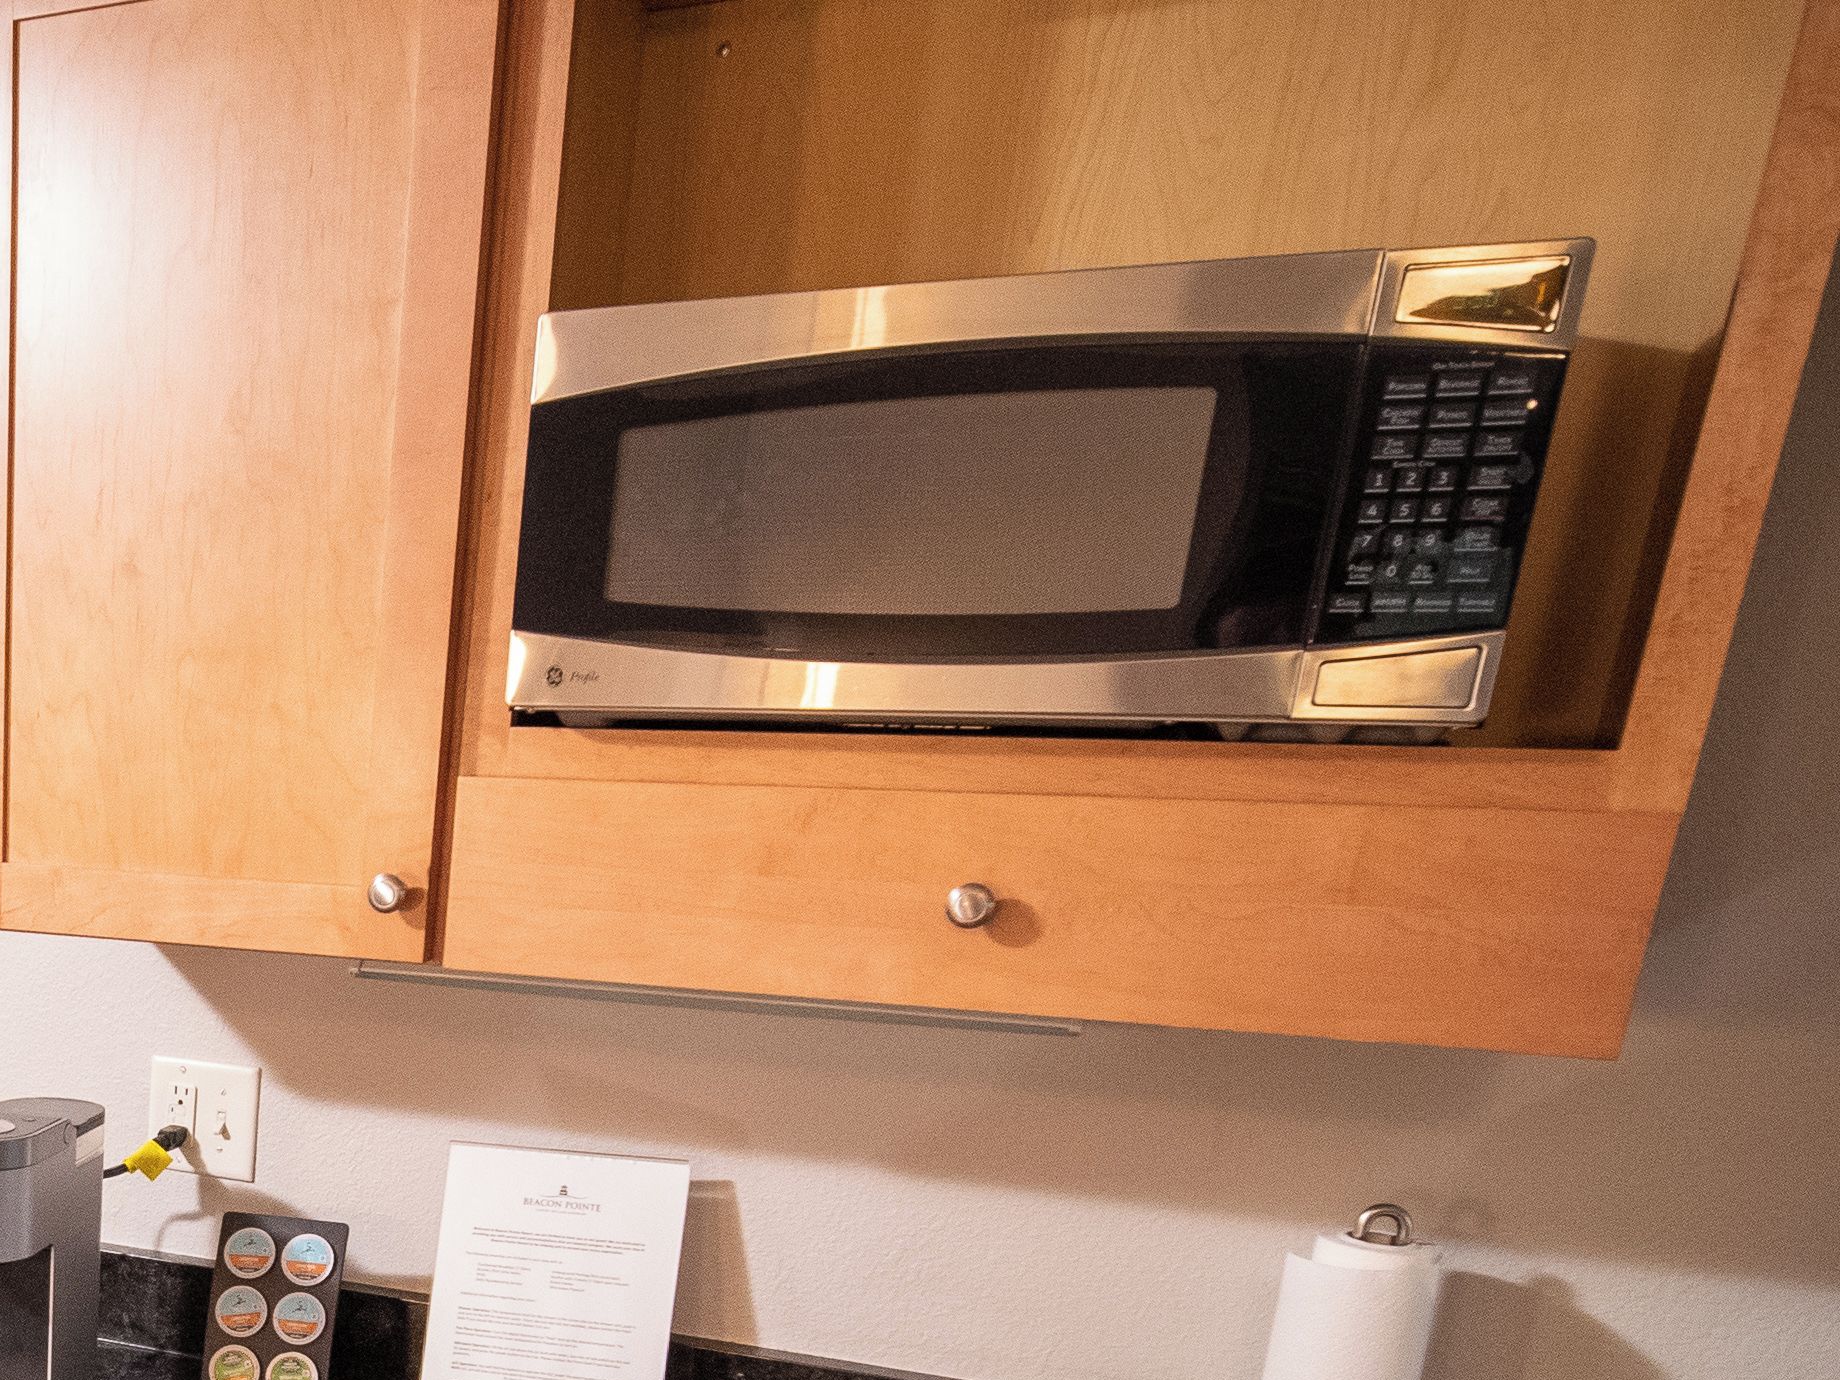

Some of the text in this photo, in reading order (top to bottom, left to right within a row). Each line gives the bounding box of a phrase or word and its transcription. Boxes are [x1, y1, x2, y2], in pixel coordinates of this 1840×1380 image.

[1375, 471, 1450, 486] 1 2 3
[1366, 502, 1442, 517] 4 5 6
[1361, 533, 1436, 548] 7 8 9
[1386, 565, 1397, 577] 0
[522, 1197, 563, 1208] BEACON
[565, 1201, 602, 1213] POINTE
